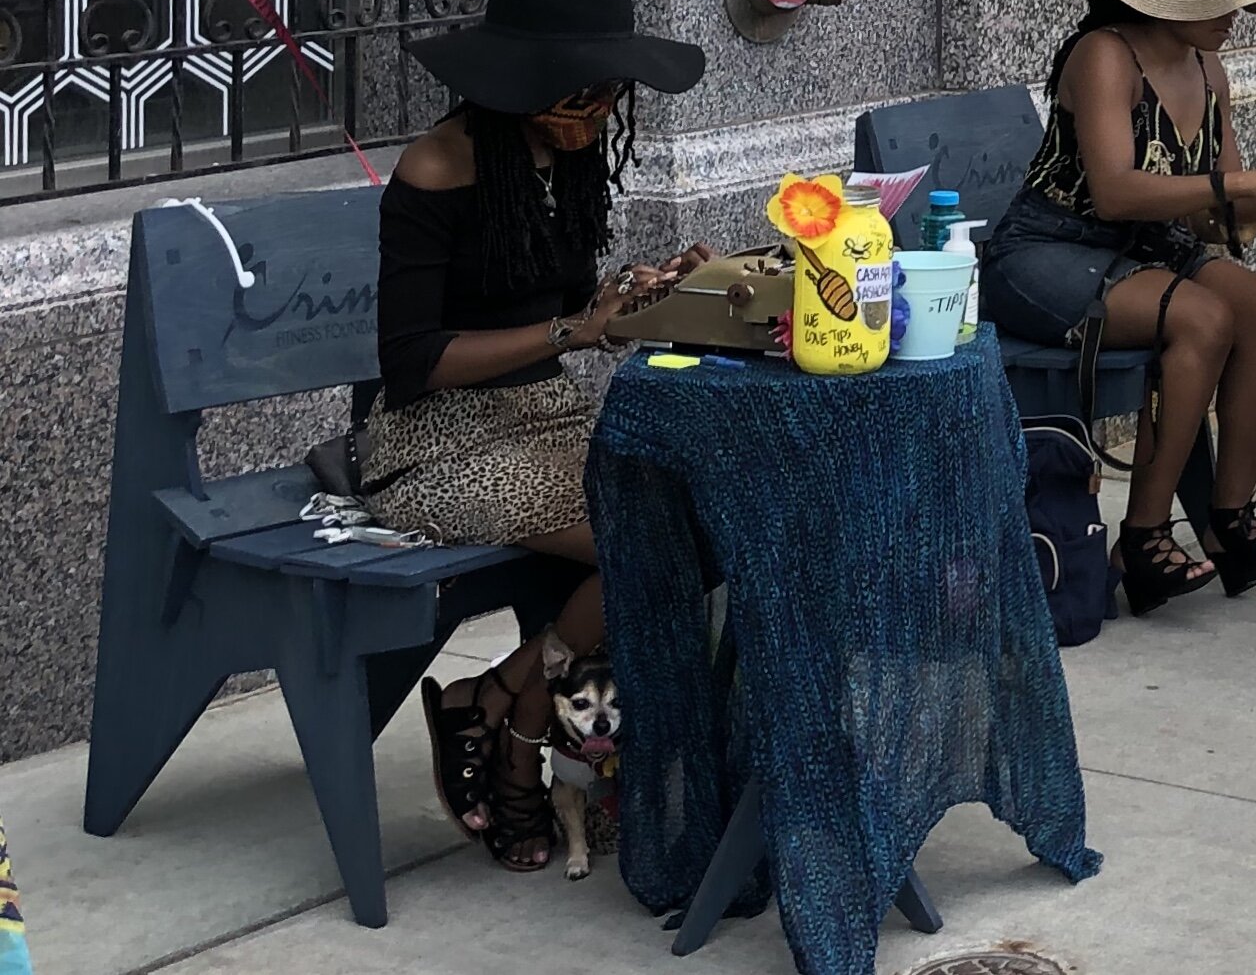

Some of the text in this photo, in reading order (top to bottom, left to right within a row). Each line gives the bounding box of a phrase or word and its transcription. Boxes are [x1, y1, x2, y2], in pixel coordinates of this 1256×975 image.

[856, 268, 880, 282] CASH
[930, 292, 964, 313] TIPS
[804, 312, 820, 328] WE
[275, 318, 378, 347] FITNESS FOUNDA
[805, 329, 828, 346] LOVE
[833, 342, 864, 361] HONEY
